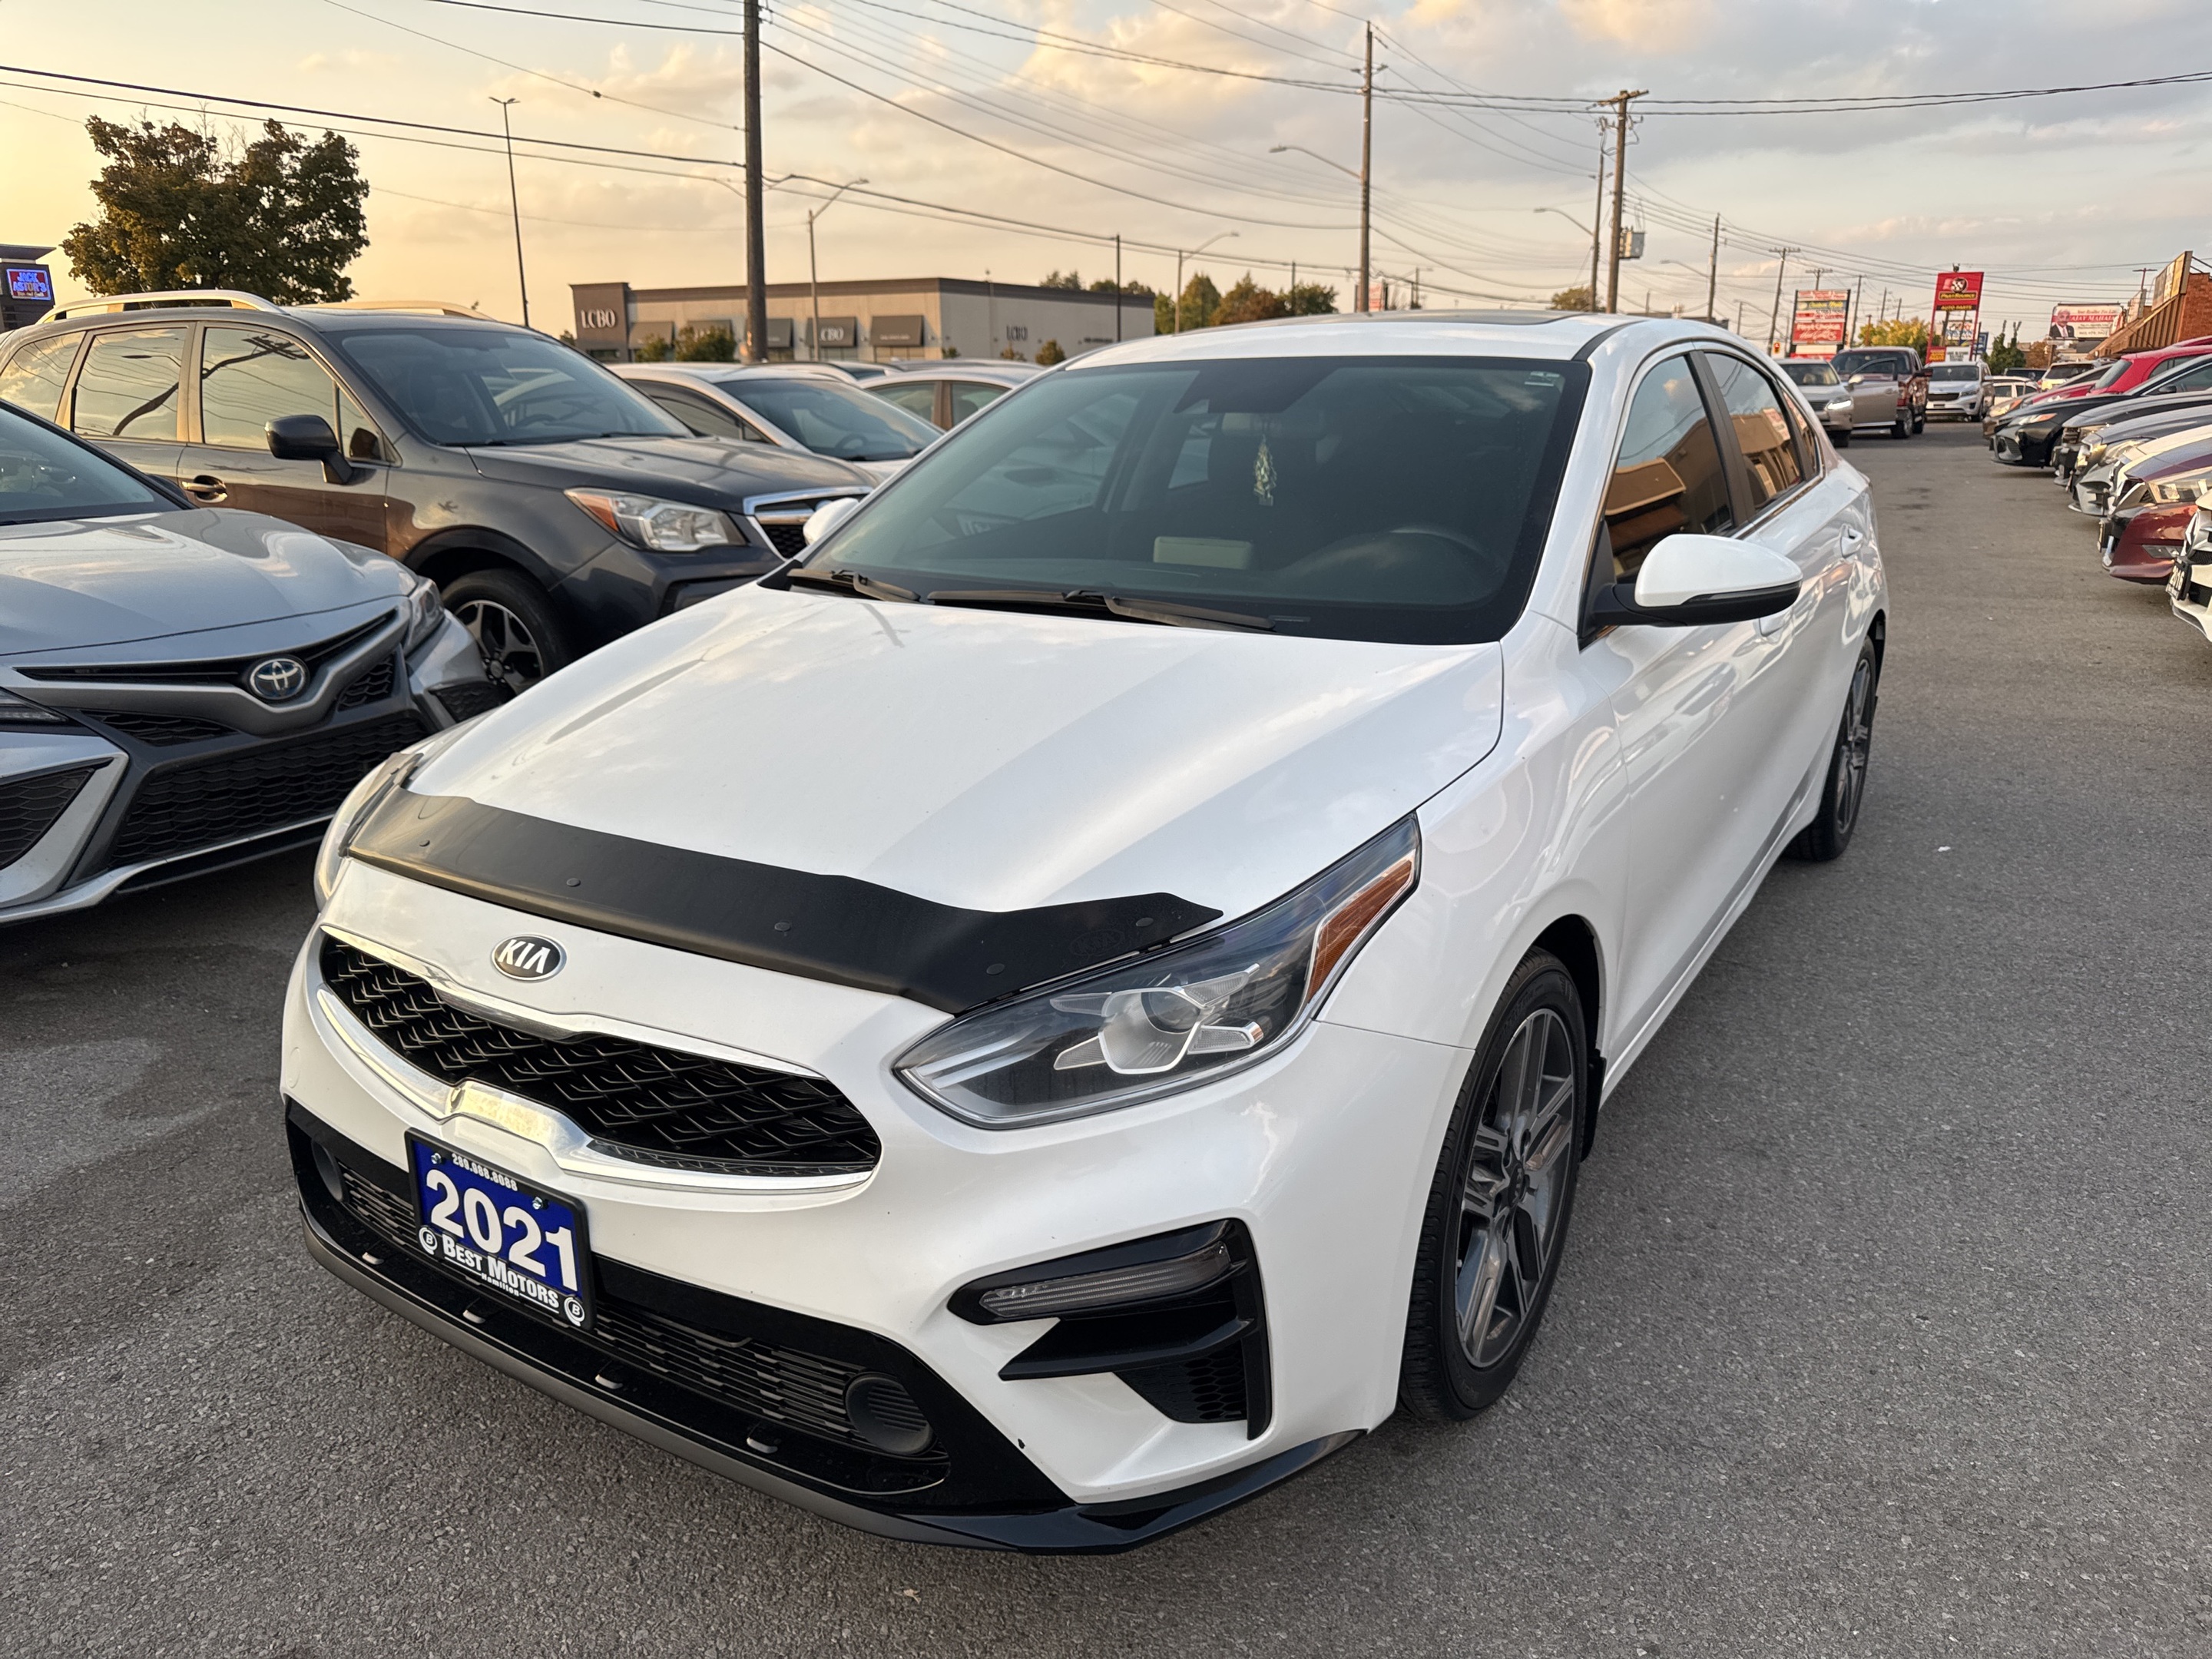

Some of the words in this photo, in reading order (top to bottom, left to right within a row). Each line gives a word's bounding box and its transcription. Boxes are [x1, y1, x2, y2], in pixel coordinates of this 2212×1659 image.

[17, 272, 38, 282] JACK
[581, 309, 616, 329] LCBO
[819, 326, 844, 342] CBO
[1006, 326, 1028, 341] LCBO
[498, 939, 551, 974] KIA
[452, 1153, 518, 1191] 289.988.8088
[426, 1169, 578, 1292] 2021
[442, 1233, 482, 1271] BEST
[487, 1255, 559, 1309] MOTORS
[481, 1273, 520, 1296] Hamilton
